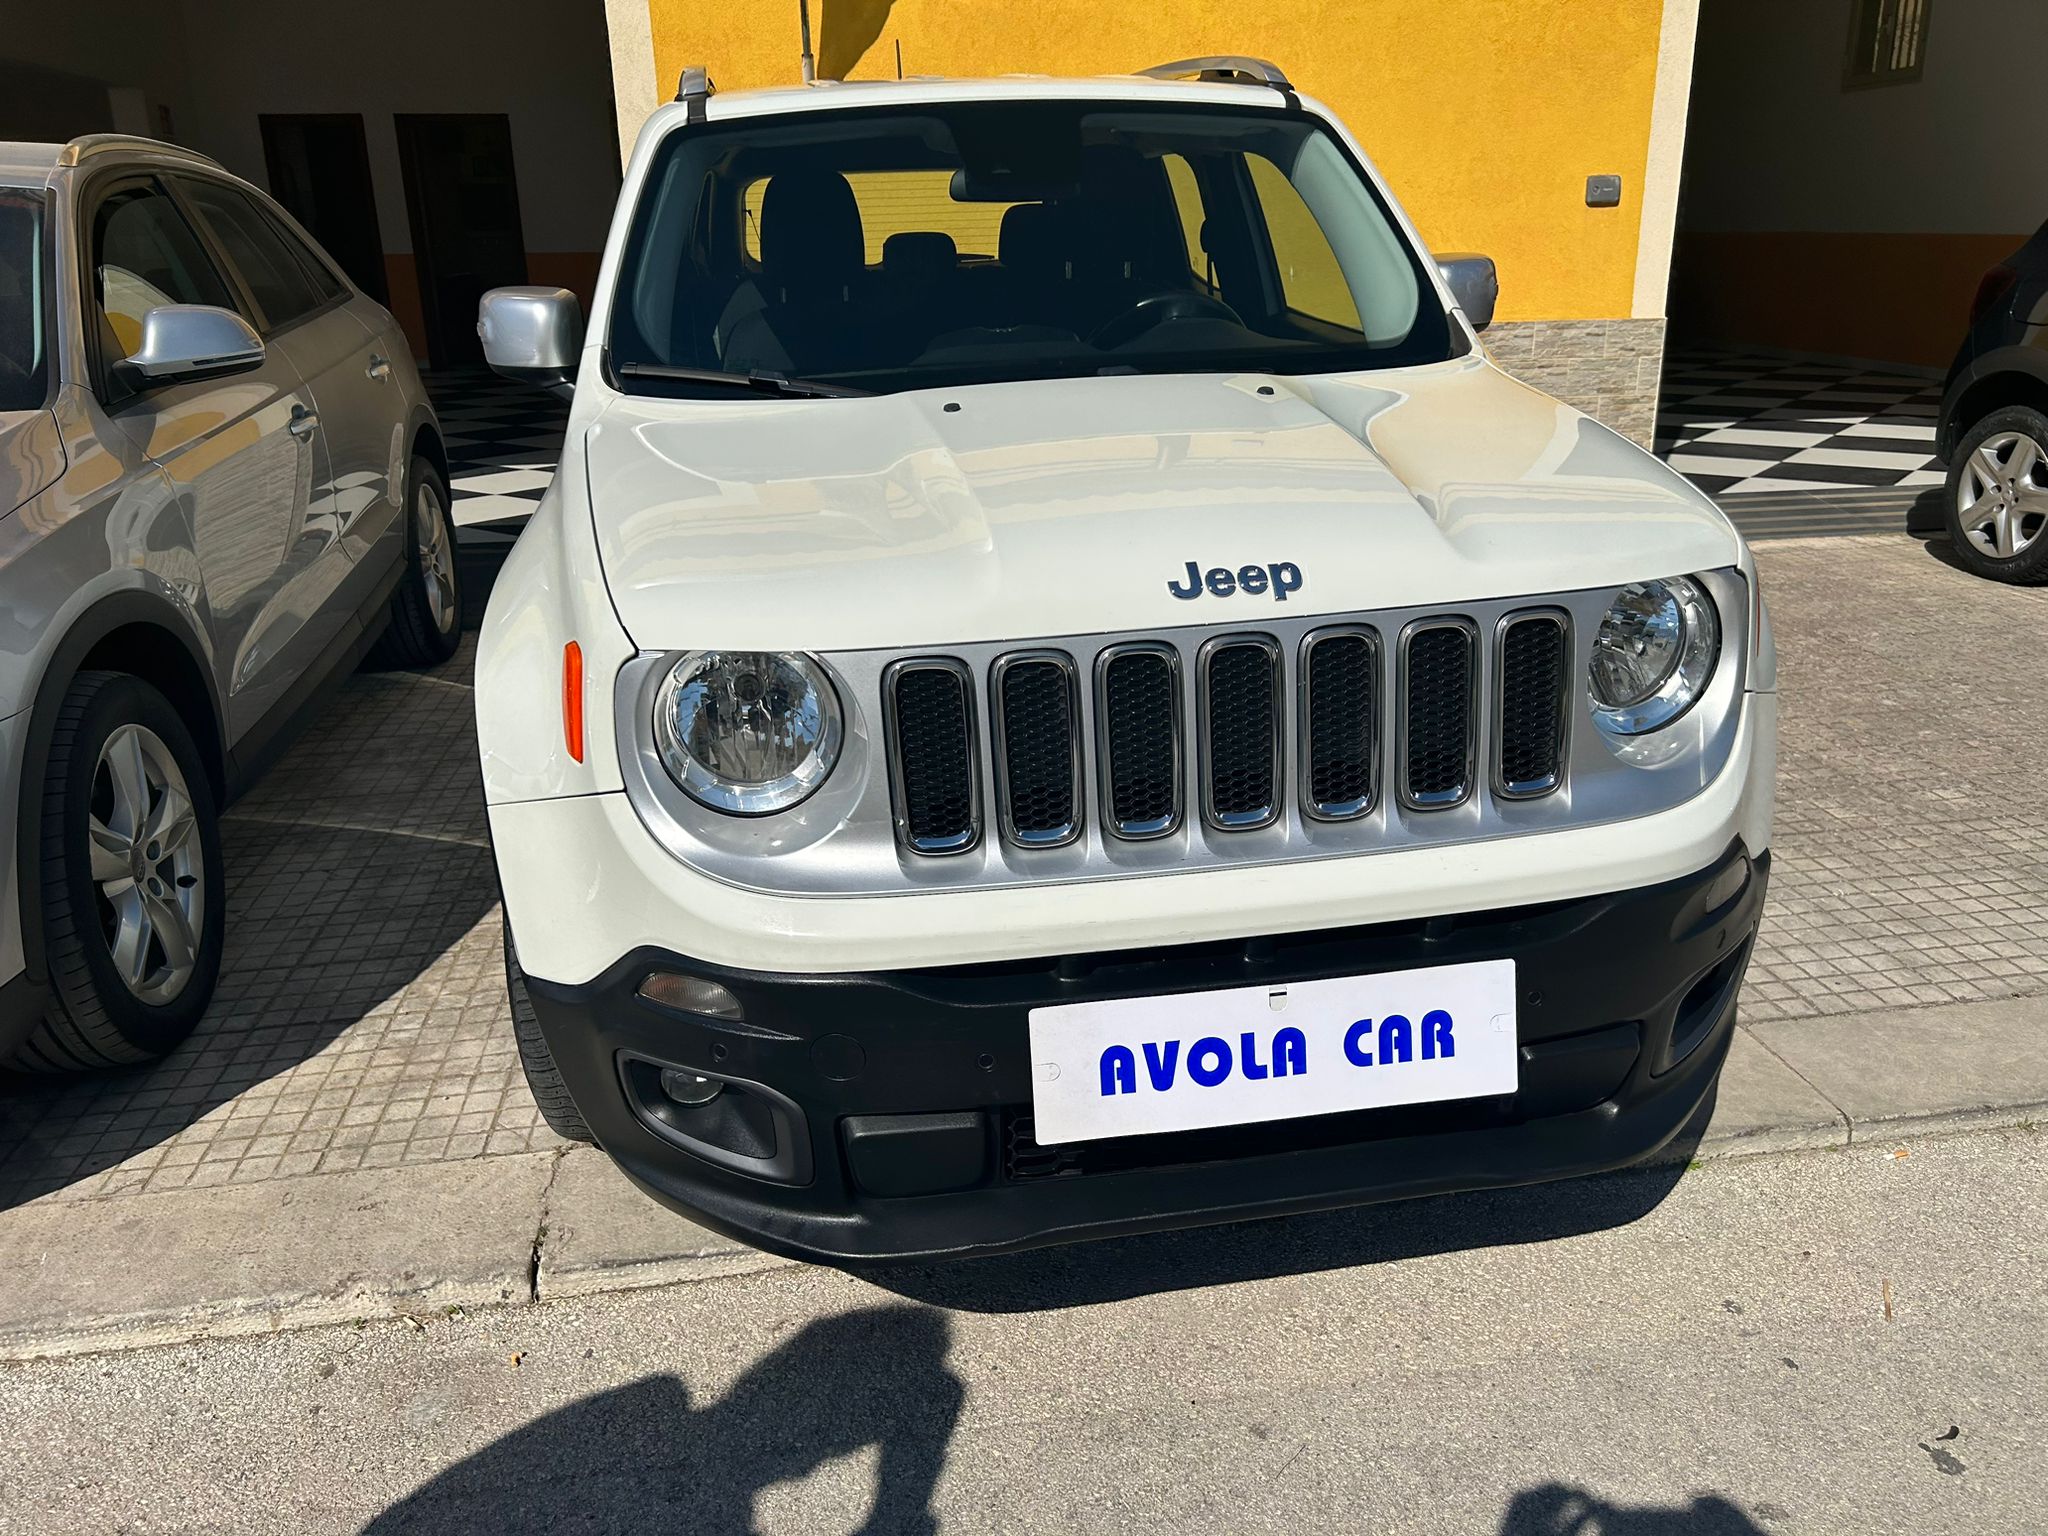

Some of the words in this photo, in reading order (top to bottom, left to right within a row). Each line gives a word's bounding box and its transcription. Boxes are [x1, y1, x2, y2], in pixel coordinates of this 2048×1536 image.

[1167, 561, 1303, 602] Jeep
[1100, 1027, 1307, 1097] AVOLA
[1343, 1009, 1455, 1068] CAR
